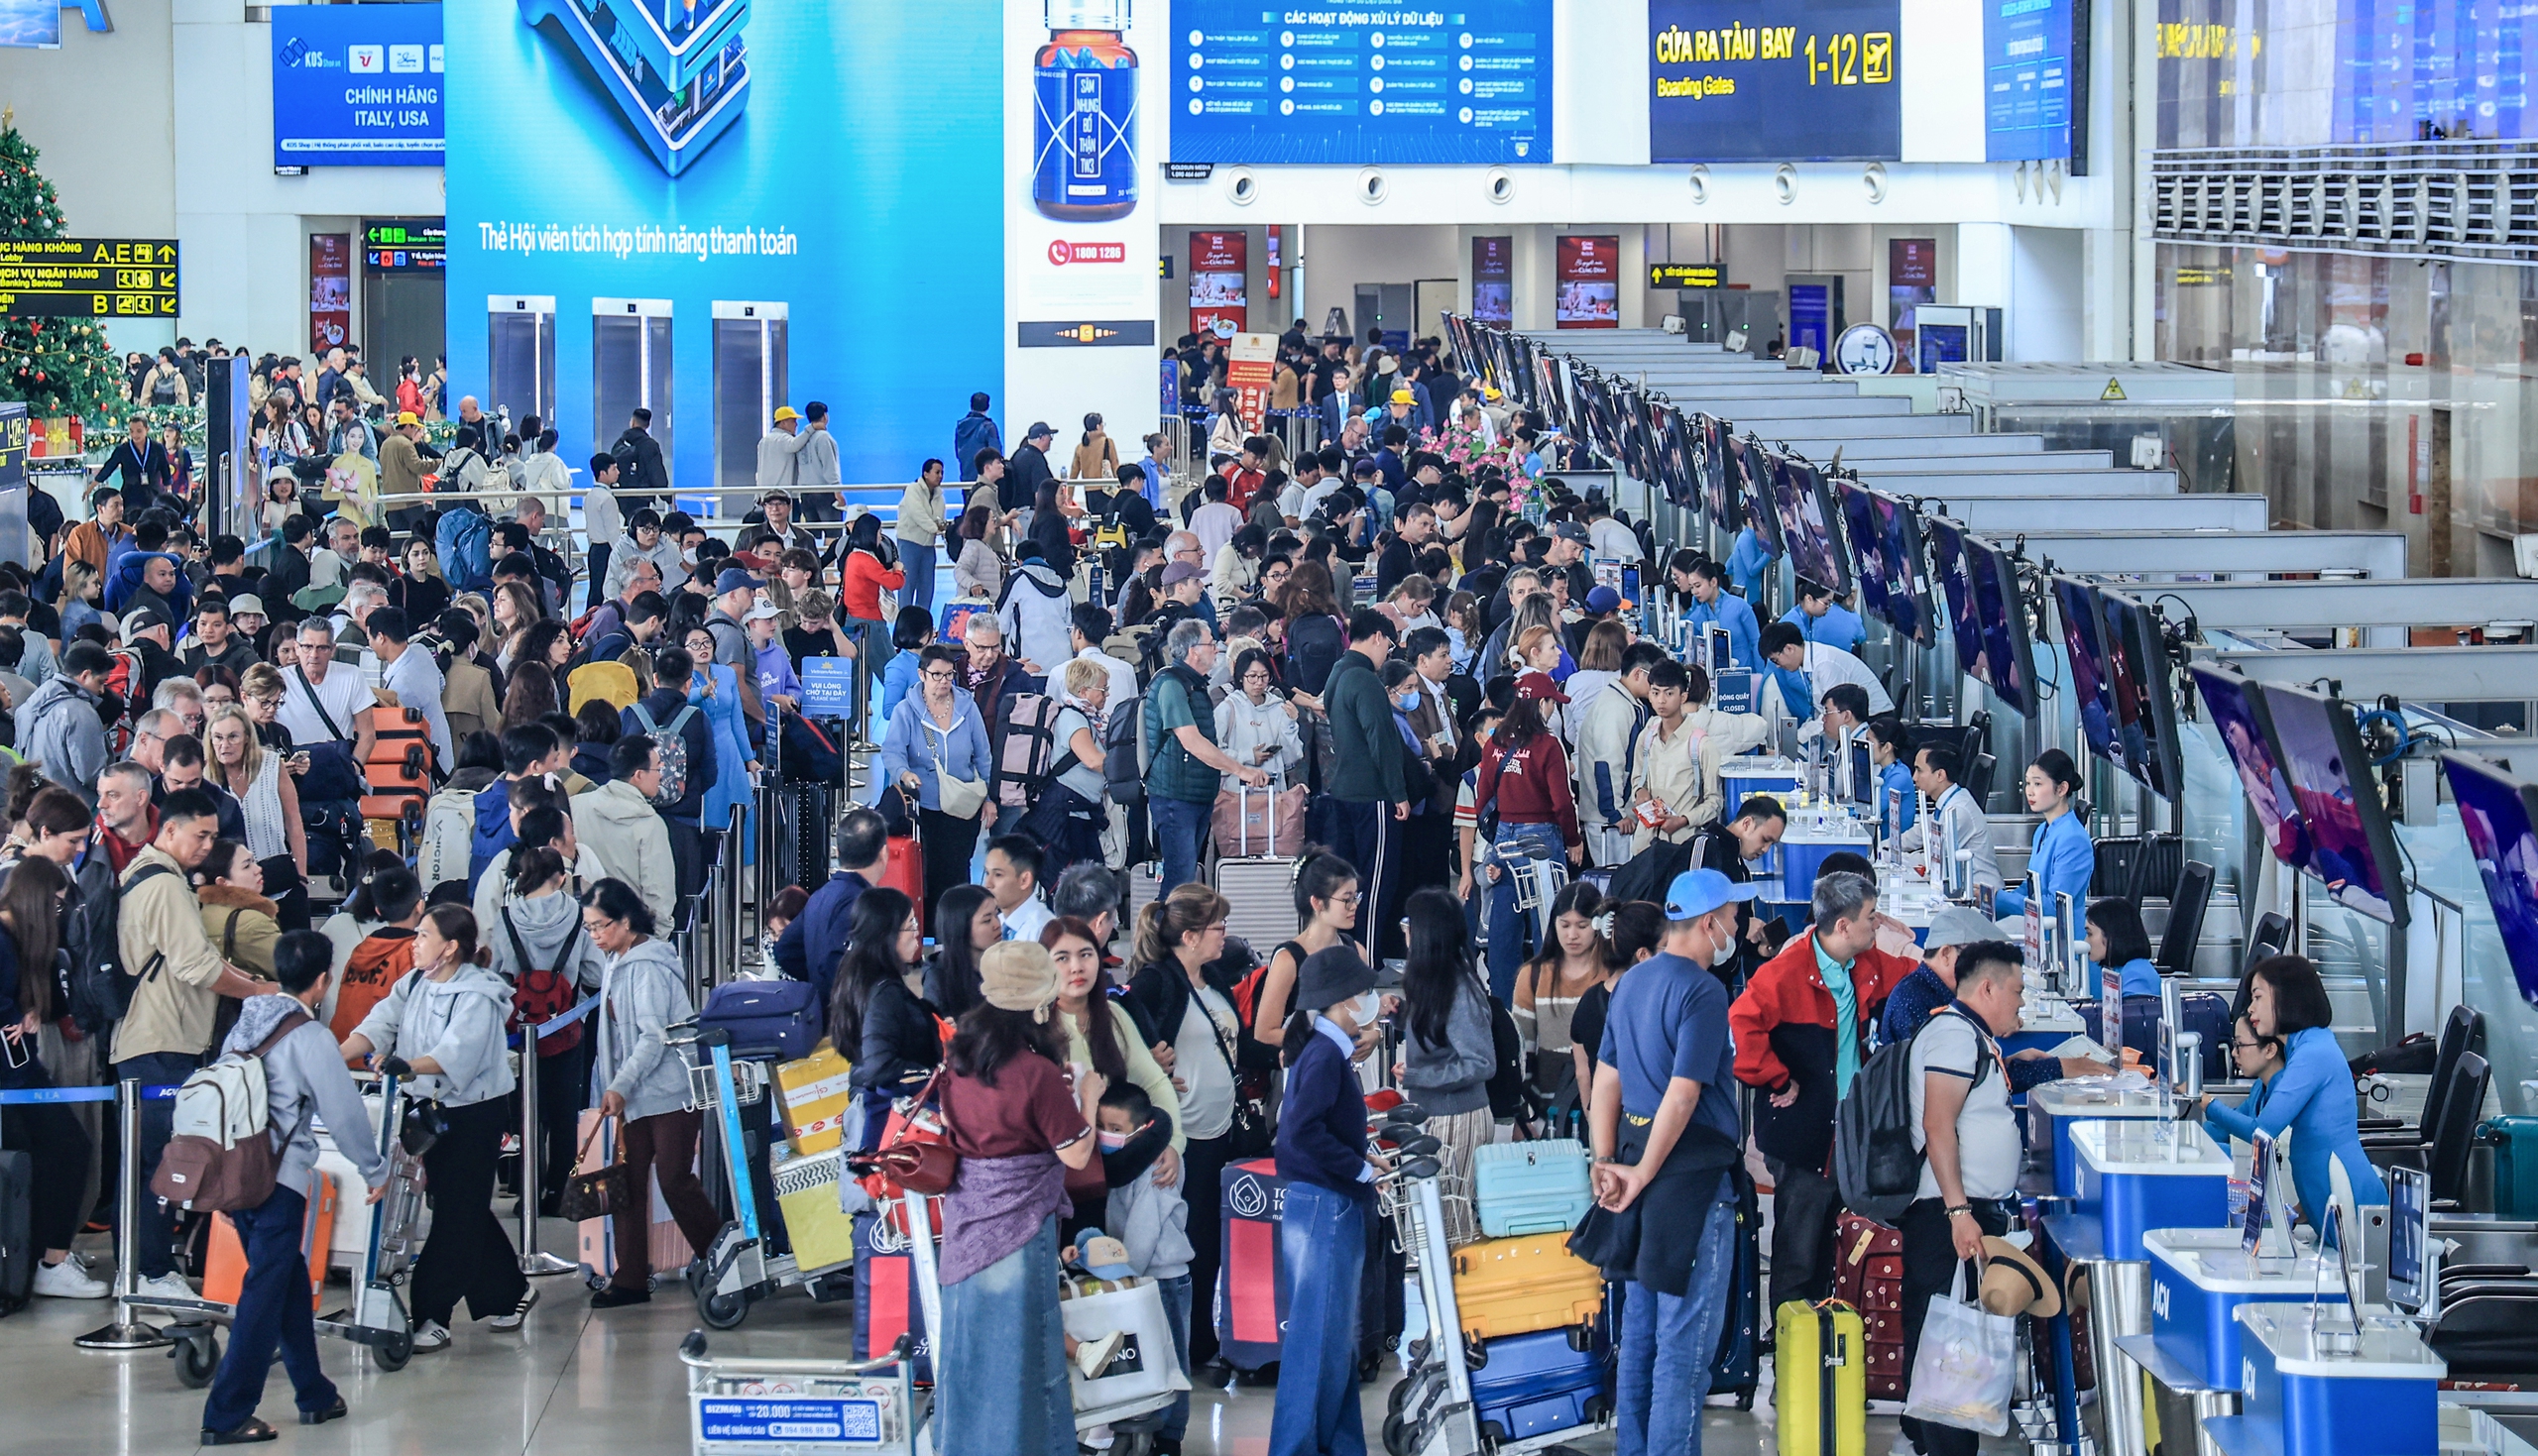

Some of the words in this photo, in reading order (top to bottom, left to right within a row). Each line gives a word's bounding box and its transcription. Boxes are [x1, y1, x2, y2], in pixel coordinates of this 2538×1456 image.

[1284, 9, 1307, 25] CÁC
[1309, 12, 1337, 27] HOẠT
[1338, 10, 1369, 27] ĐỘNG
[1370, 10, 1387, 25] XỬ
[1388, 10, 1401, 25] LÝ
[1403, 11, 1419, 25] DỮ
[1419, 11, 1443, 28] LIỆU
[1657, 25, 1693, 63] CỬA
[1695, 30, 1720, 61] RA
[1721, 21, 1756, 60] TÀU
[1761, 27, 1796, 59] BAY
[305, 52, 323, 67] KOS
[1804, 33, 1858, 85] 1-12
[345, 85, 392, 104] CHÍNH
[396, 84, 437, 104] HÃNG
[1081, 77, 1095, 93] SÂM
[1657, 77, 1701, 100] Boarding
[1702, 75, 1735, 95] Gates
[1077, 98, 1098, 113] NHUNG
[355, 110, 395, 129] ITALY,
[399, 110, 429, 126] USA
[1079, 136, 1096, 155] THẬN
[1081, 159, 1095, 173] TW3
[12, 241, 43, 253] HÀNG
[45, 241, 82, 253] KHÔNG
[479, 220, 508, 251] Thẻ
[510, 223, 535, 257] Hội
[537, 223, 569, 252] viên
[571, 223, 601, 252] tích
[604, 224, 633, 261] hợp
[635, 224, 666, 254] tính
[668, 225, 707, 263] năng
[710, 225, 756, 255] thanh
[759, 225, 797, 255] toán
[0, 254, 23, 263] Lobby
[93, 243, 131, 265] A,E
[1075, 246, 1097, 260] 1800
[1098, 246, 1121, 259] 1286
[21, 269, 35, 280] VỤ
[38, 268, 67, 279] NGÂN
[68, 268, 98, 279] HÀNG
[0, 280, 30, 288] Banking
[93, 295, 108, 313] B
[7, 417, 22, 447] 1-12
[431, 835, 442, 881] VICTOR
[2152, 1279, 2170, 1320] ACV
[2243, 1356, 2256, 1400] ACV
[706, 1404, 742, 1414] BIZMAN
[756, 1404, 790, 1418] 20.000
[707, 1424, 722, 1435] LIÊN
[722, 1424, 731, 1436] HỆ
[732, 1424, 752, 1435] QUẢNG
[752, 1425, 765, 1435] CÁO
